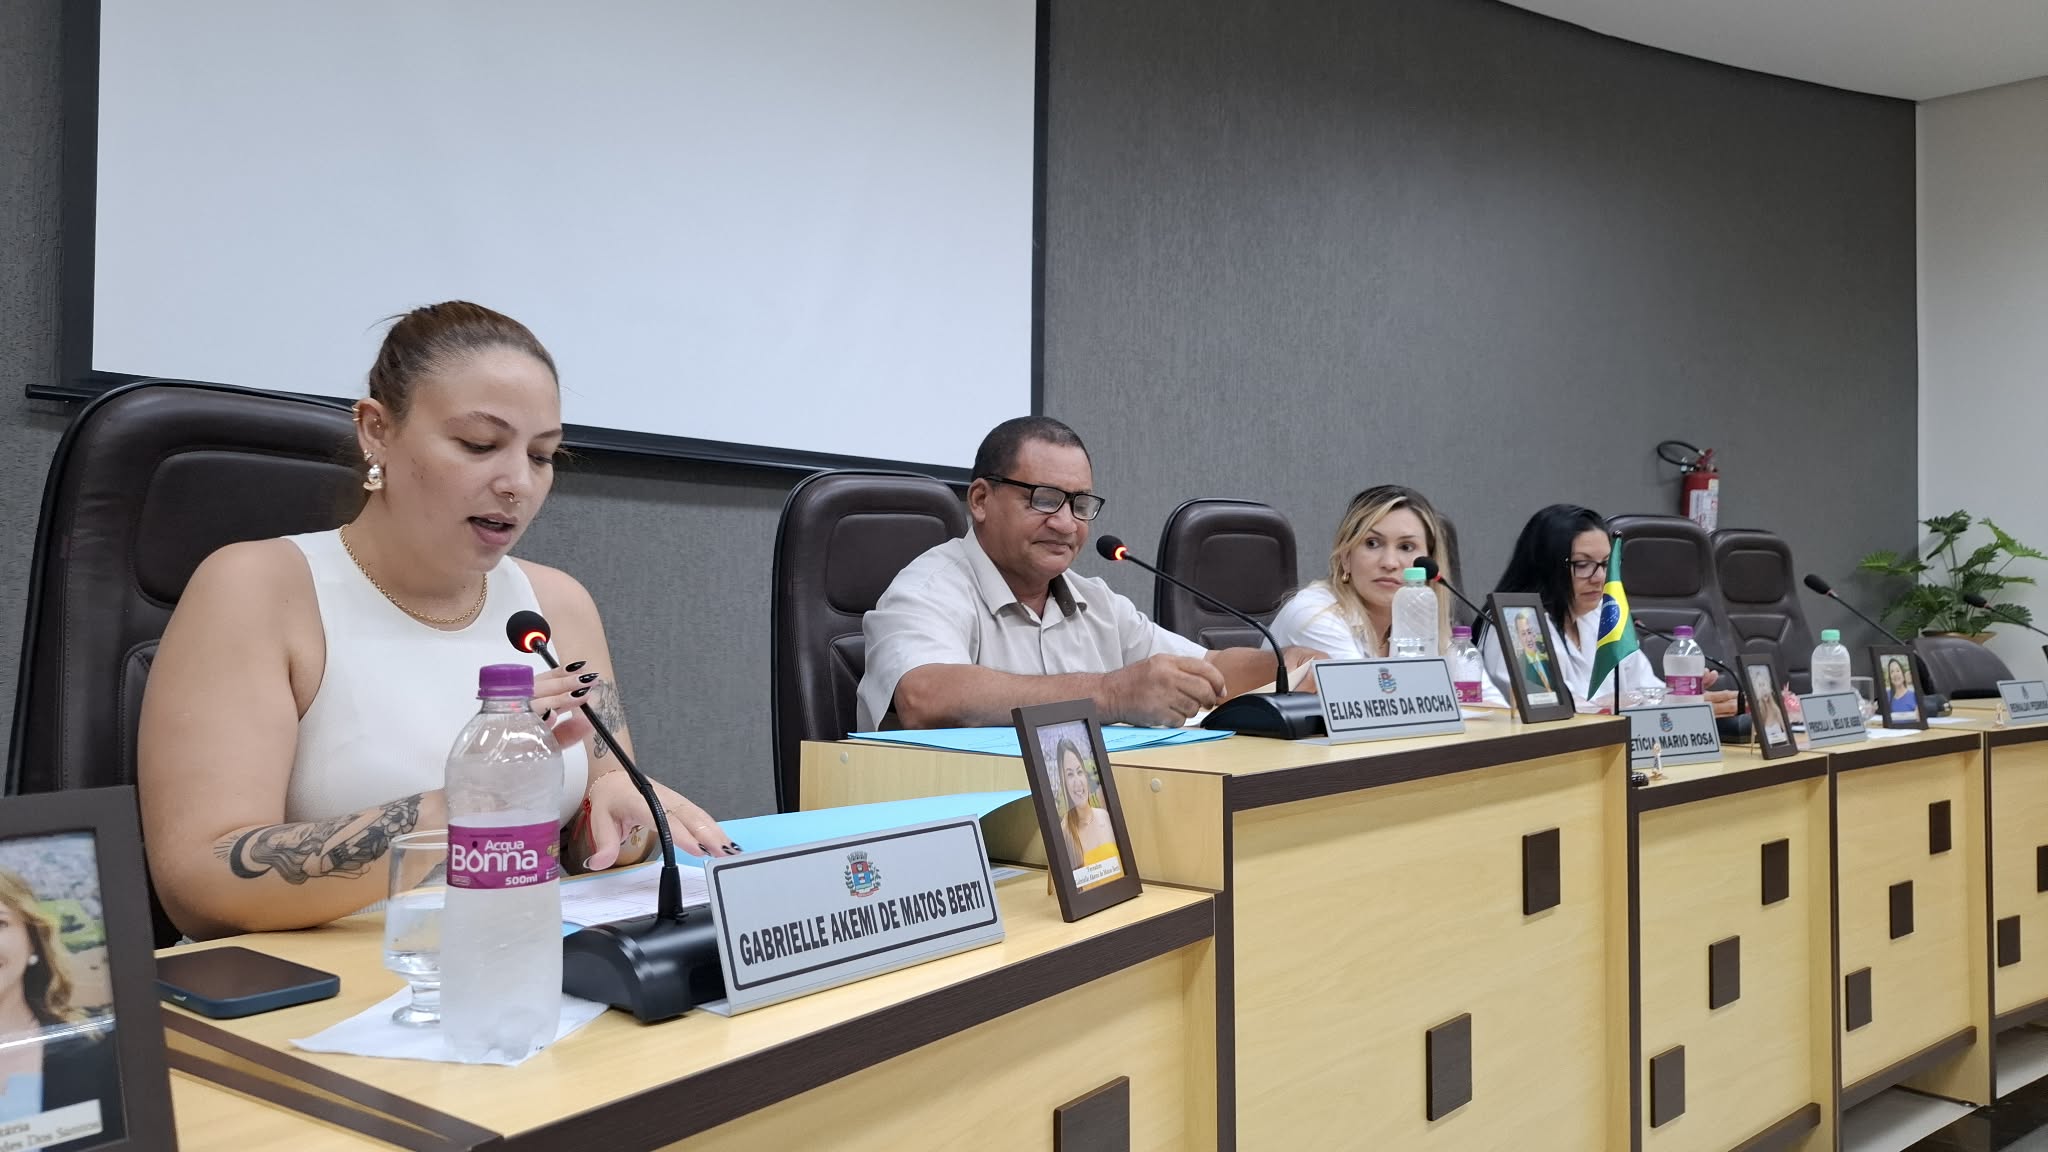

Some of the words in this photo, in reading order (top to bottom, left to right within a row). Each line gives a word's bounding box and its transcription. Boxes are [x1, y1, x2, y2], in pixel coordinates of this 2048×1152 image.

[1329, 700, 1363, 721] ELIAS
[1364, 699, 1398, 718] NERIS
[1399, 697, 1416, 715] DA
[1416, 694, 1454, 714] ROCHA
[1631, 734, 1656, 752] ETÍCIA
[1659, 734, 1689, 750] MARIO
[1690, 732, 1715, 746] ROSA
[484, 840, 525, 853] Acqua
[505, 874, 538, 886] 500ml
[739, 916, 829, 966] GABRIELLE
[831, 904, 878, 945] AKEMI
[880, 899, 900, 932] DE
[899, 889, 947, 926] MATOS
[946, 880, 985, 915] BERTI
